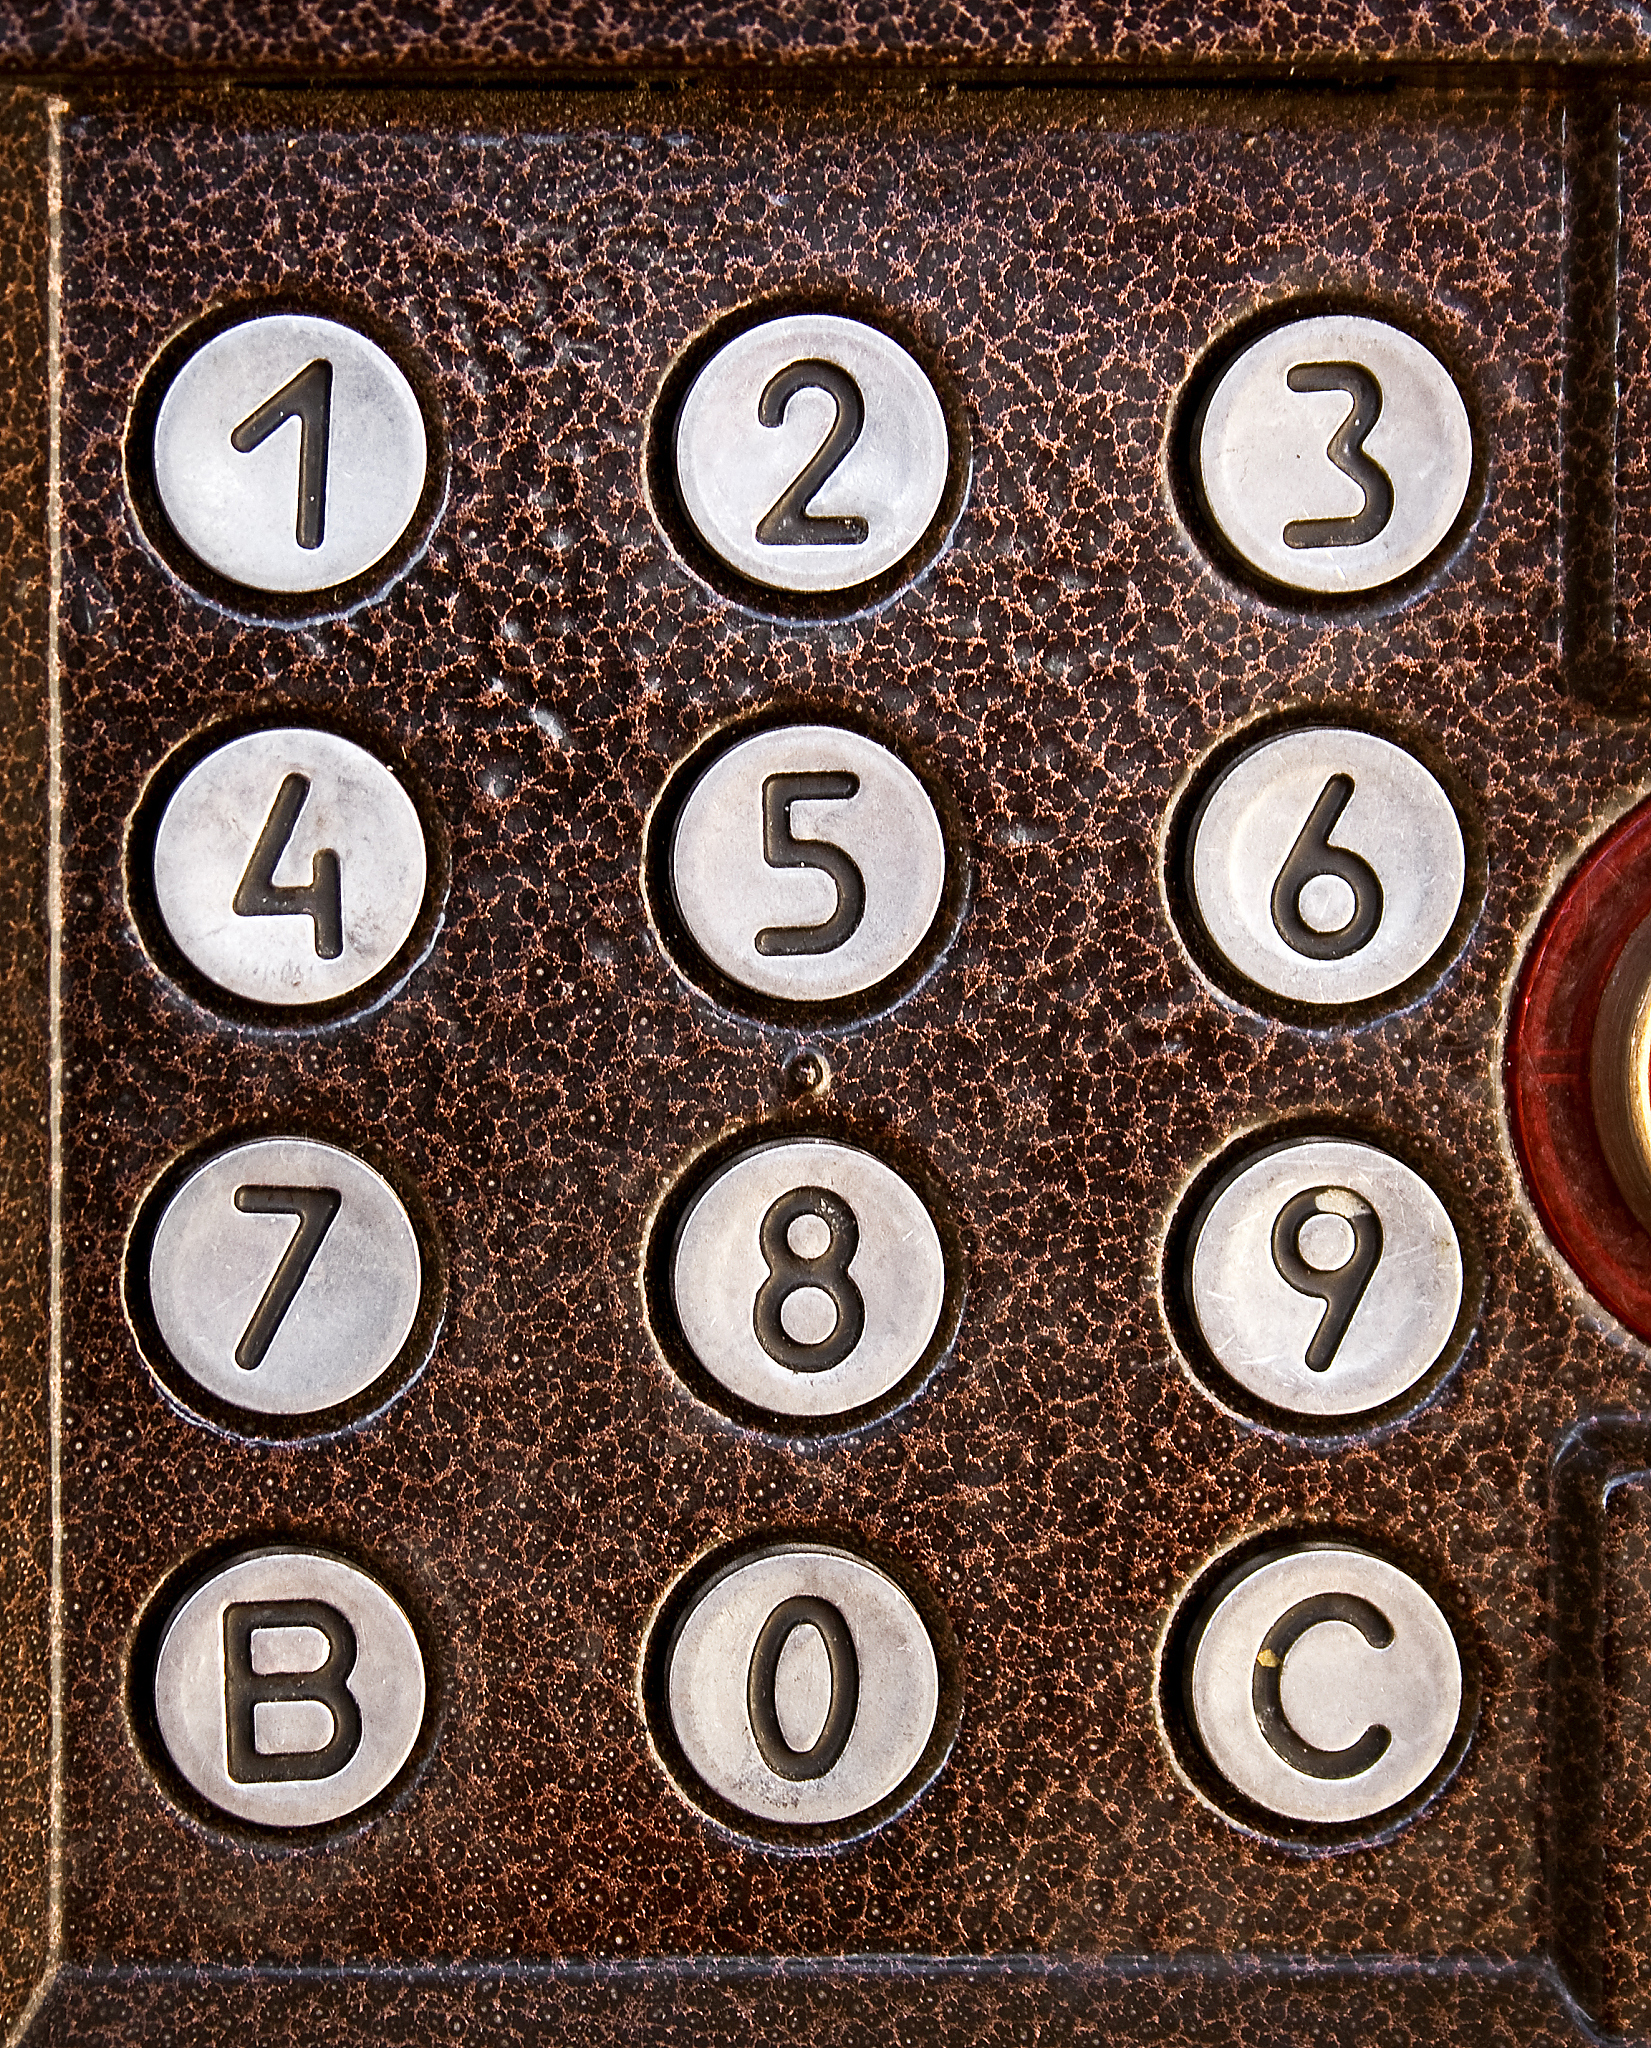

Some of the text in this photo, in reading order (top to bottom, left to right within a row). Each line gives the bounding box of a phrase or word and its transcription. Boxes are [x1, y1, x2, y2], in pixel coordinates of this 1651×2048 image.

[231, 359, 333, 549] 1
[756, 358, 868, 545] 2
[1283, 361, 1394, 549] 3
[233, 773, 343, 959] 4
[755, 770, 866, 956] 5
[1270, 773, 1383, 960] 6
[234, 1185, 342, 1370] 7
[753, 1186, 865, 1373] 8
[1271, 1186, 1383, 1372] 9
[223, 1599, 362, 1784] B
[747, 1595, 860, 1782] 0
[1252, 1593, 1394, 1779] C
